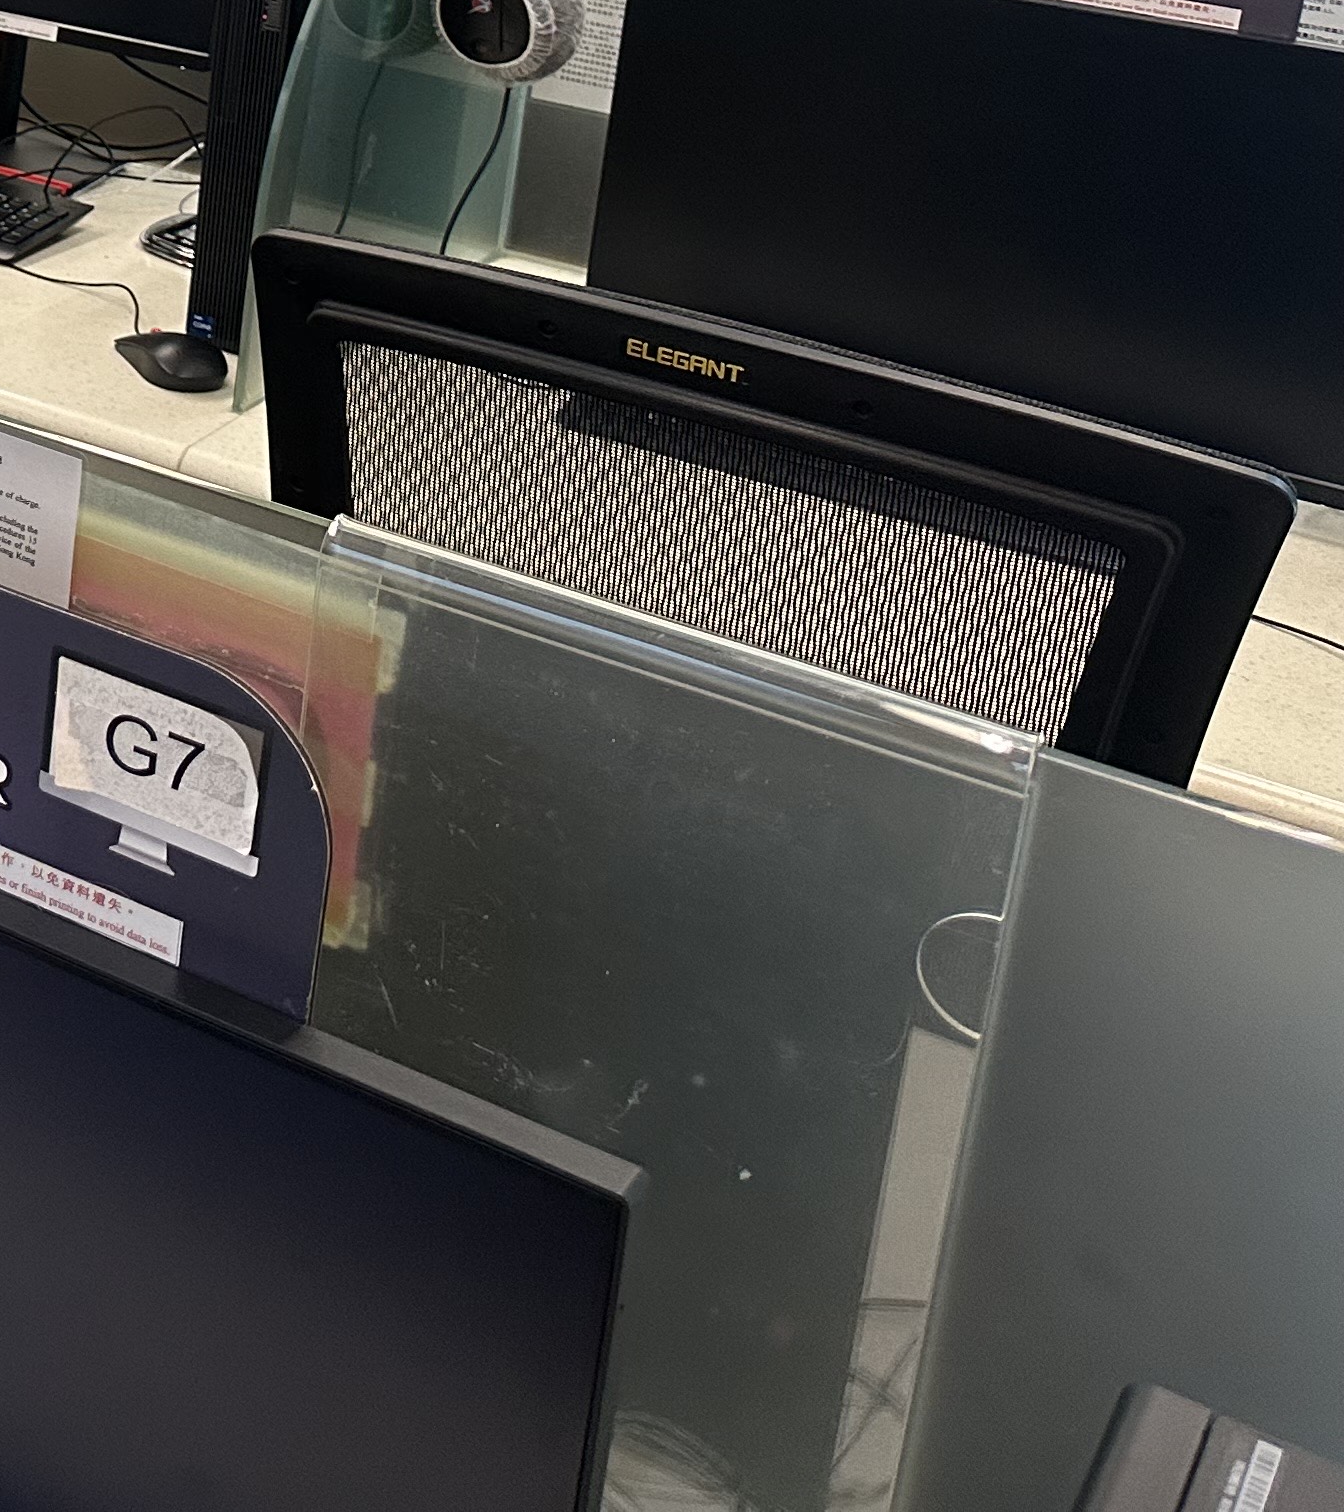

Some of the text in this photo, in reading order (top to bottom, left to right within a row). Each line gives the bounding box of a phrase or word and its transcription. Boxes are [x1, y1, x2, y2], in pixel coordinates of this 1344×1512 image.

[625, 336, 748, 384] ELEGANT
[107, 713, 206, 792] G7
[8, 880, 20, 890] or
[21, 883, 47, 903] finish
[48, 897, 85, 920] printing
[87, 912, 97, 924] to
[98, 918, 125, 936] avoid
[126, 929, 147, 946] data
[148, 937, 170, 956] loss.
